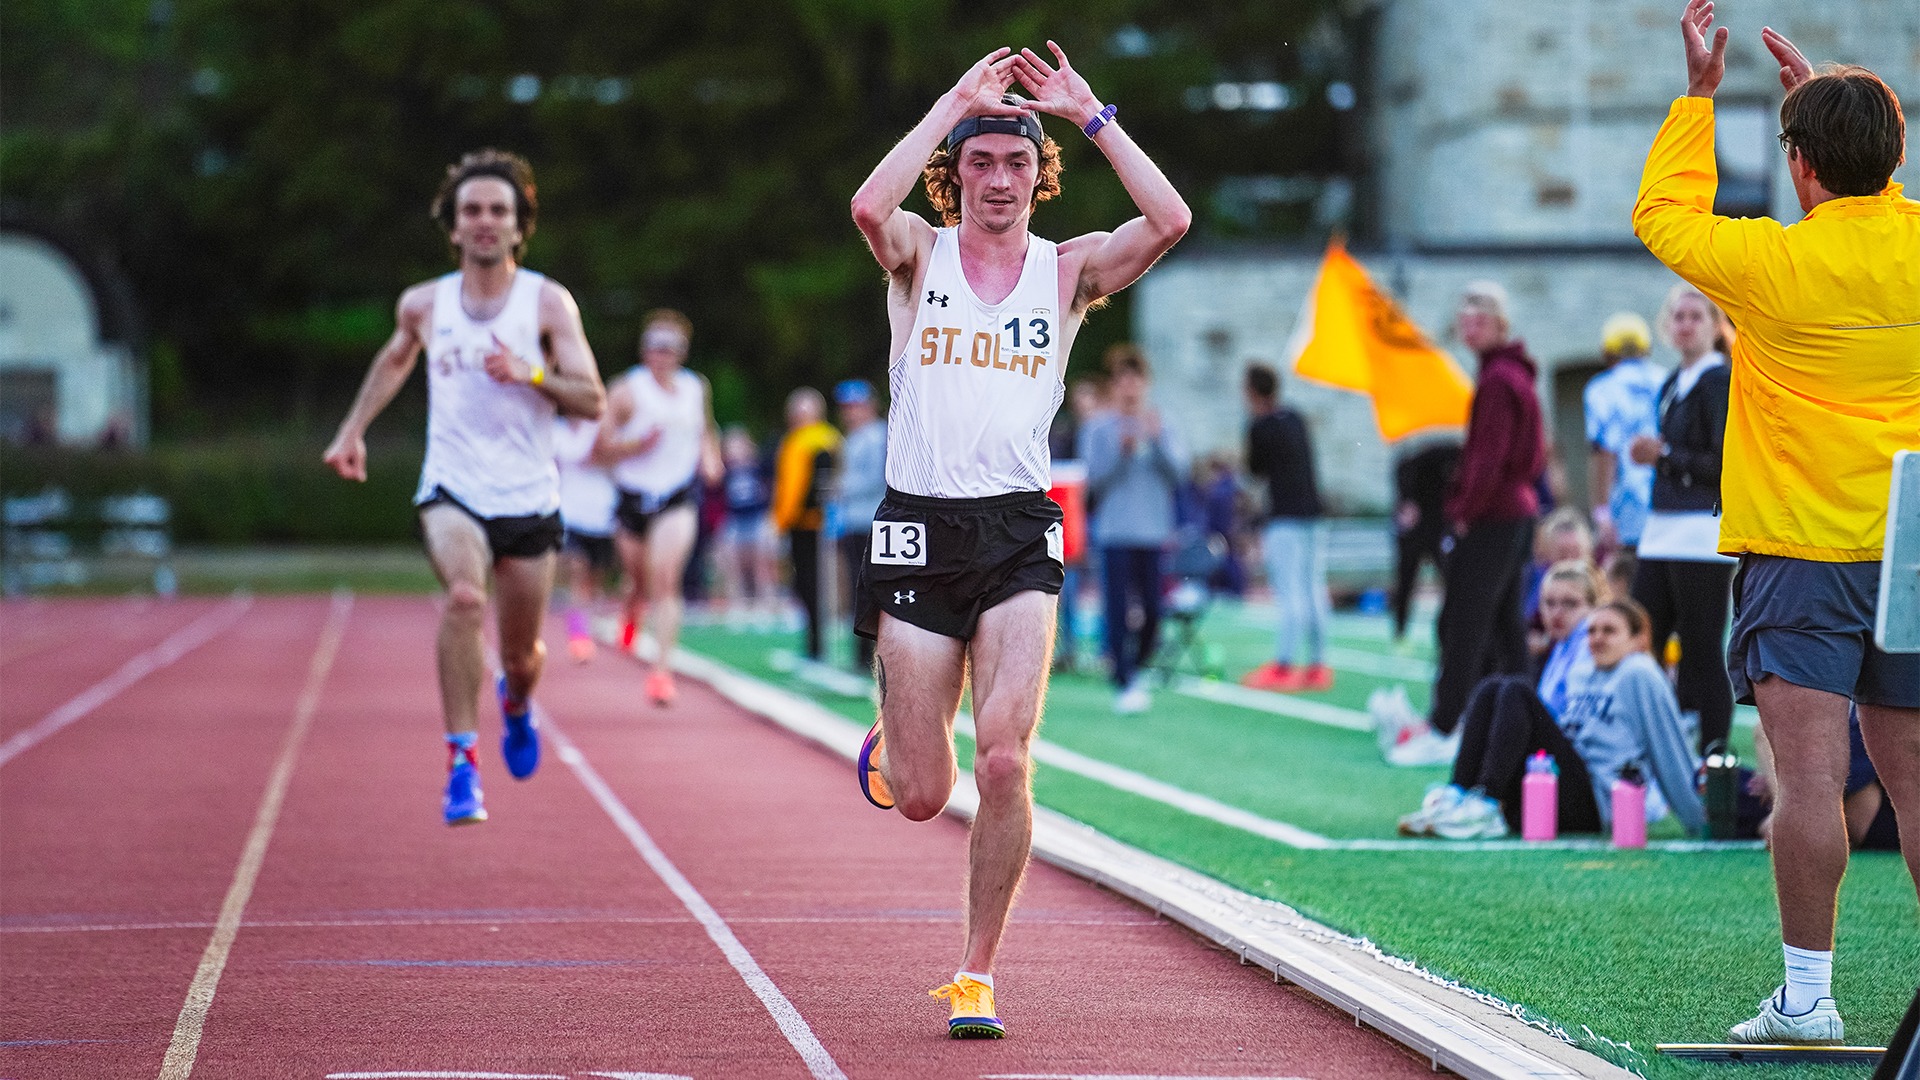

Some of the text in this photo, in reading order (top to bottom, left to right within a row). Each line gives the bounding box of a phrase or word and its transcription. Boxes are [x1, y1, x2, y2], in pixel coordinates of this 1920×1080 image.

[921, 327, 962, 366] ST.
[1004, 317, 1051, 349] 13
[880, 525, 921, 559] 13
